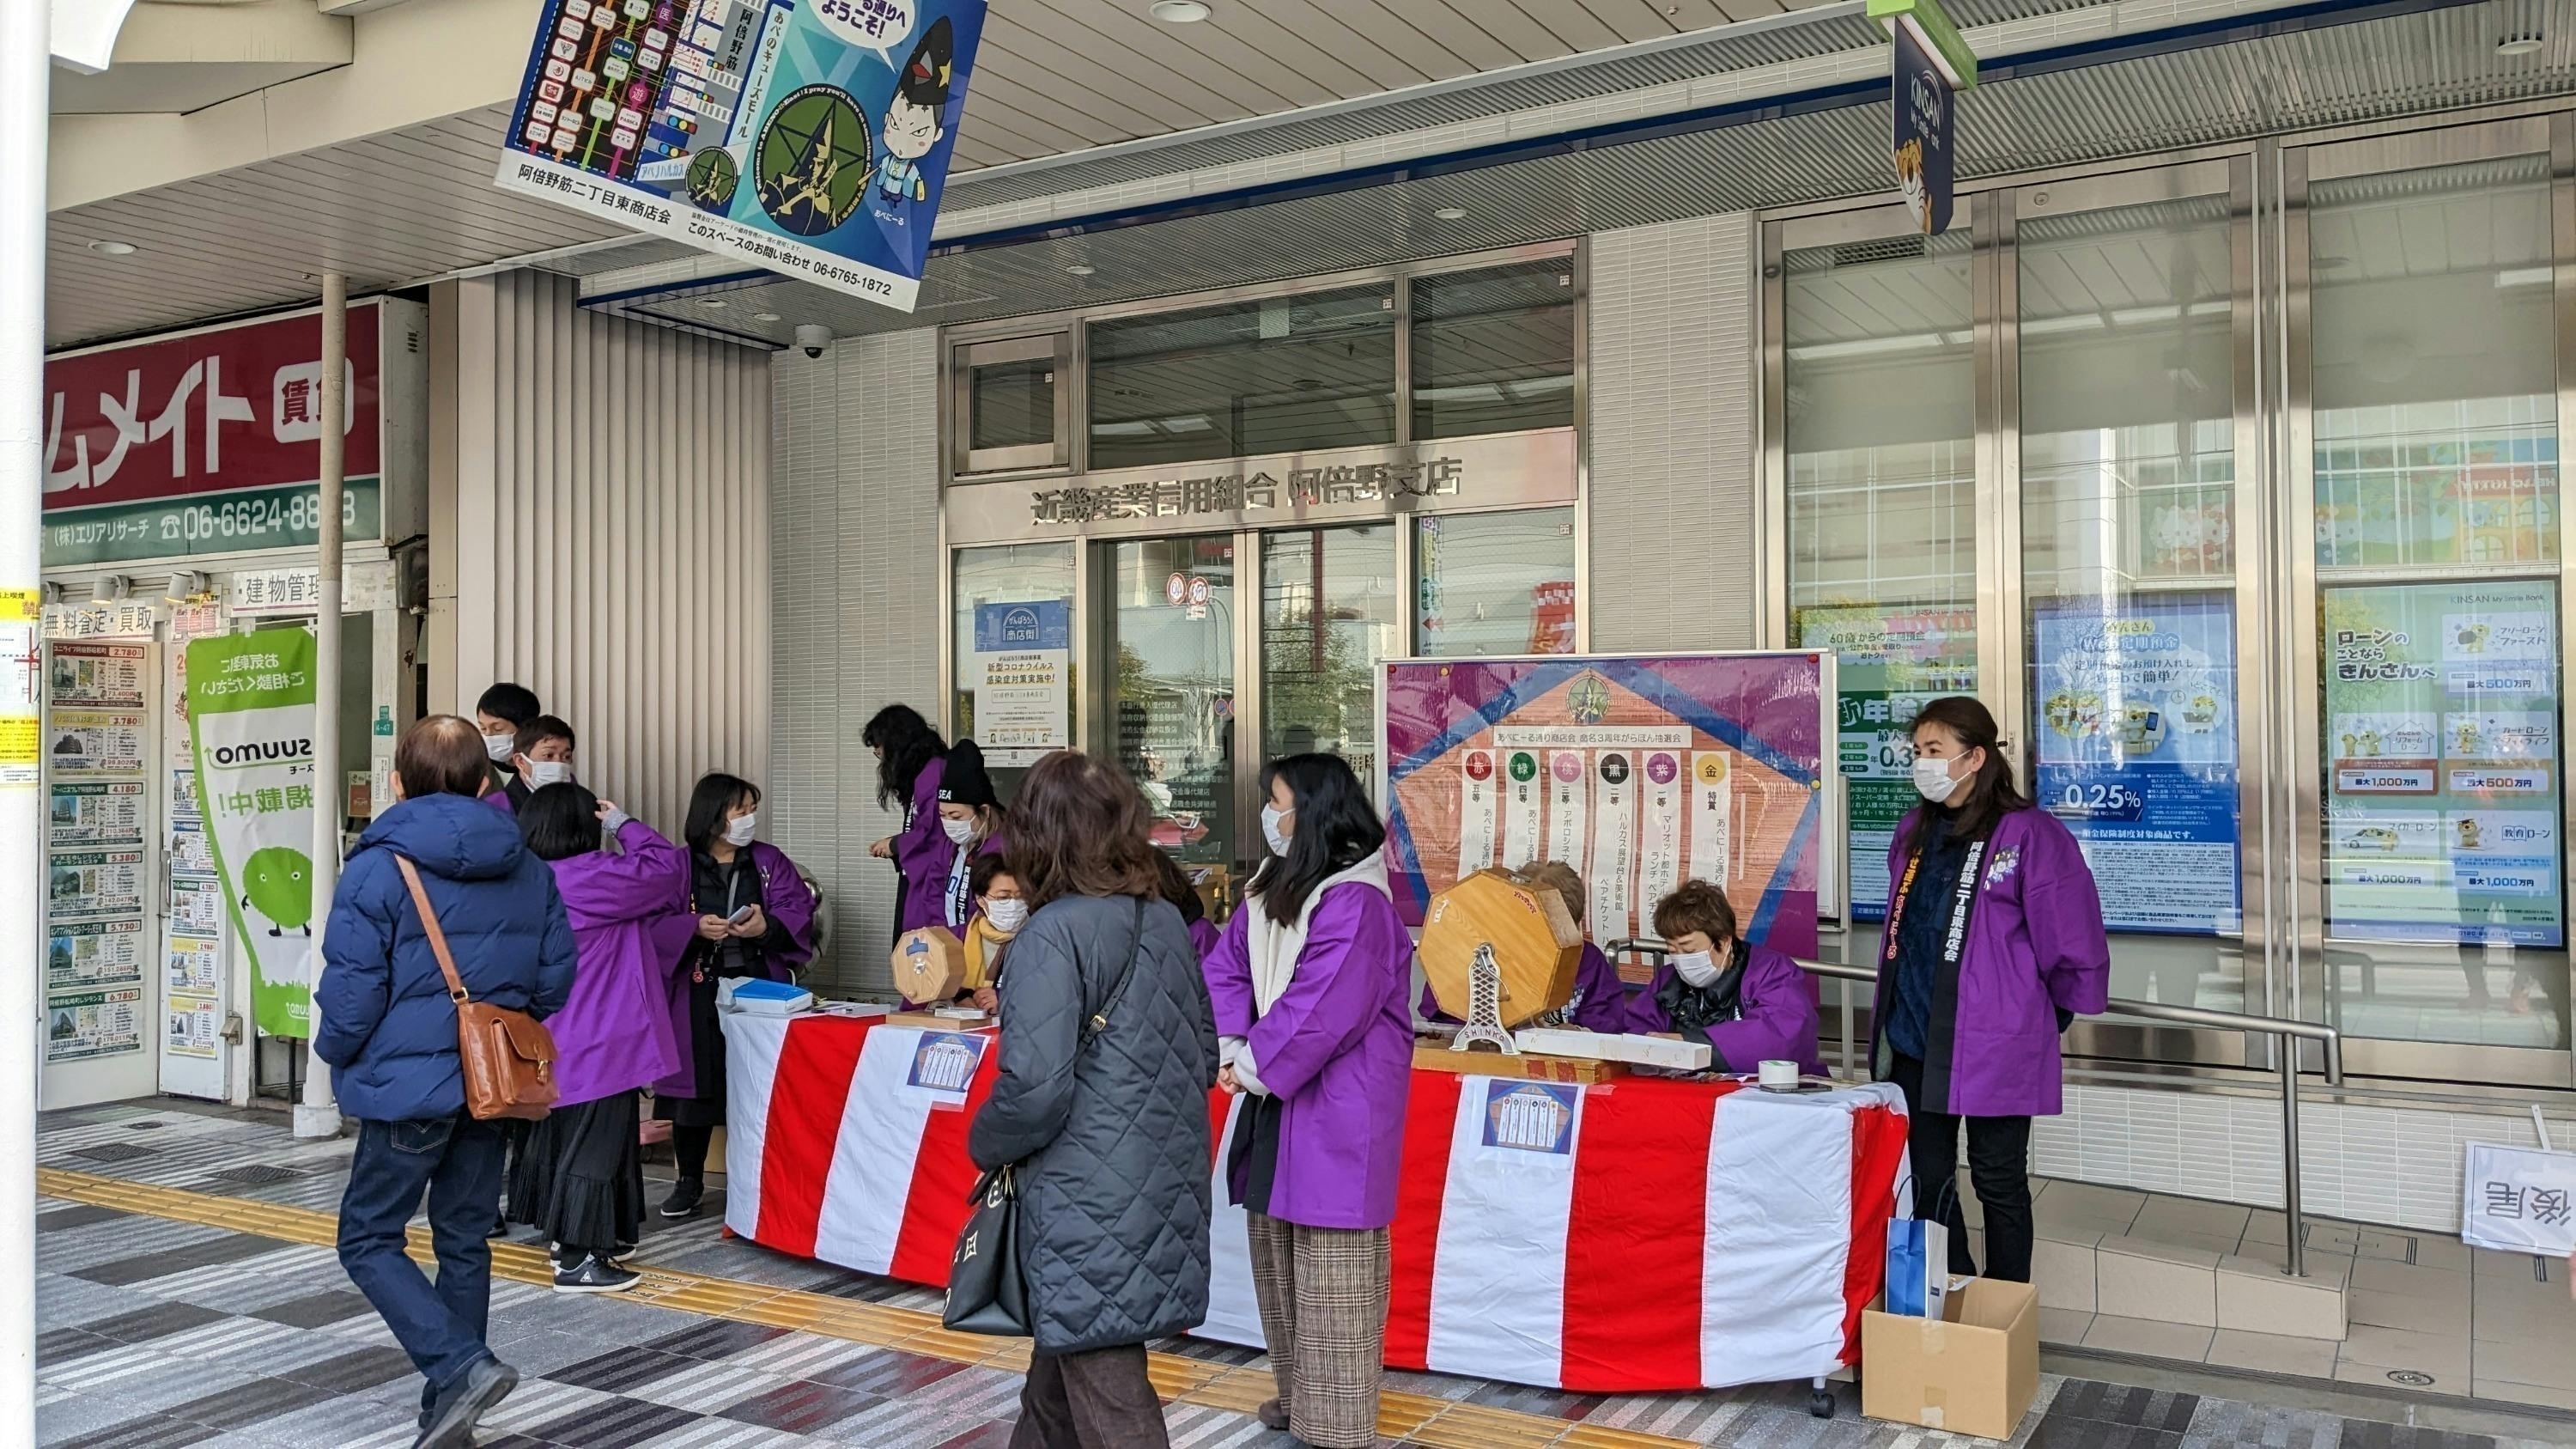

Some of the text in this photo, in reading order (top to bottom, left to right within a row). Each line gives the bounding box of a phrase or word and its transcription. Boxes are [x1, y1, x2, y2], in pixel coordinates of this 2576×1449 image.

[659, 7, 671, 21] 医
[725, 8, 754, 71] 阿倍野筋
[738, 10, 785, 138] あべのキューズモール
[631, 86, 645, 101] 遊
[1911, 72, 1940, 131] KINSAN
[518, 163, 672, 225] 阿倍野筋二丁目東商店会
[874, 209, 905, 227] あべにーる
[688, 222, 892, 296] このスペースのお問い合わせ 06-6765-1872
[1030, 456, 1463, 526] 近畿産業信用組合 阿倍野支店
[184, 490, 355, 541] 06-6624-888
[1006, 629, 1036, 642] 商店街
[2337, 629, 2409, 646] ローンの
[2500, 636, 2547, 646] ファースト
[2336, 648, 2385, 660] ことなら
[987, 662, 1054, 673] 新型コロナウイルス
[2337, 662, 2437, 680] きんさんへ
[987, 673, 1055, 685] 感染症対策実施中!
[2467, 679, 2531, 689] 最大500万円
[1498, 733, 1575, 744] あべにーる通り商店会
[1472, 761, 1485, 775] 赤
[1516, 762, 1529, 775] 緑
[1608, 764, 1621, 777] 黒
[1655, 764, 1668, 776] 紫
[1704, 764, 1718, 778] 金
[2355, 777, 2419, 788] 最大1,000万円
[2467, 778, 2533, 788] 最大500万円
[938, 789, 952, 801] SEA
[1707, 790, 1717, 811] 特賞
[2064, 783, 2142, 809] 0.25%
[2504, 826, 2551, 839] 教育ローン
[1614, 812, 1628, 911] ハルカス展望台&美術館
[1649, 851, 1659, 878] ランチ
[2358, 874, 2422, 885] 最大1,000万円
[2469, 876, 2535, 887] 最大1,000万円
[1944, 841, 1984, 962] 阿倍野筋二丁目東商店会
[2485, 1180, 2573, 1227] 後尾
